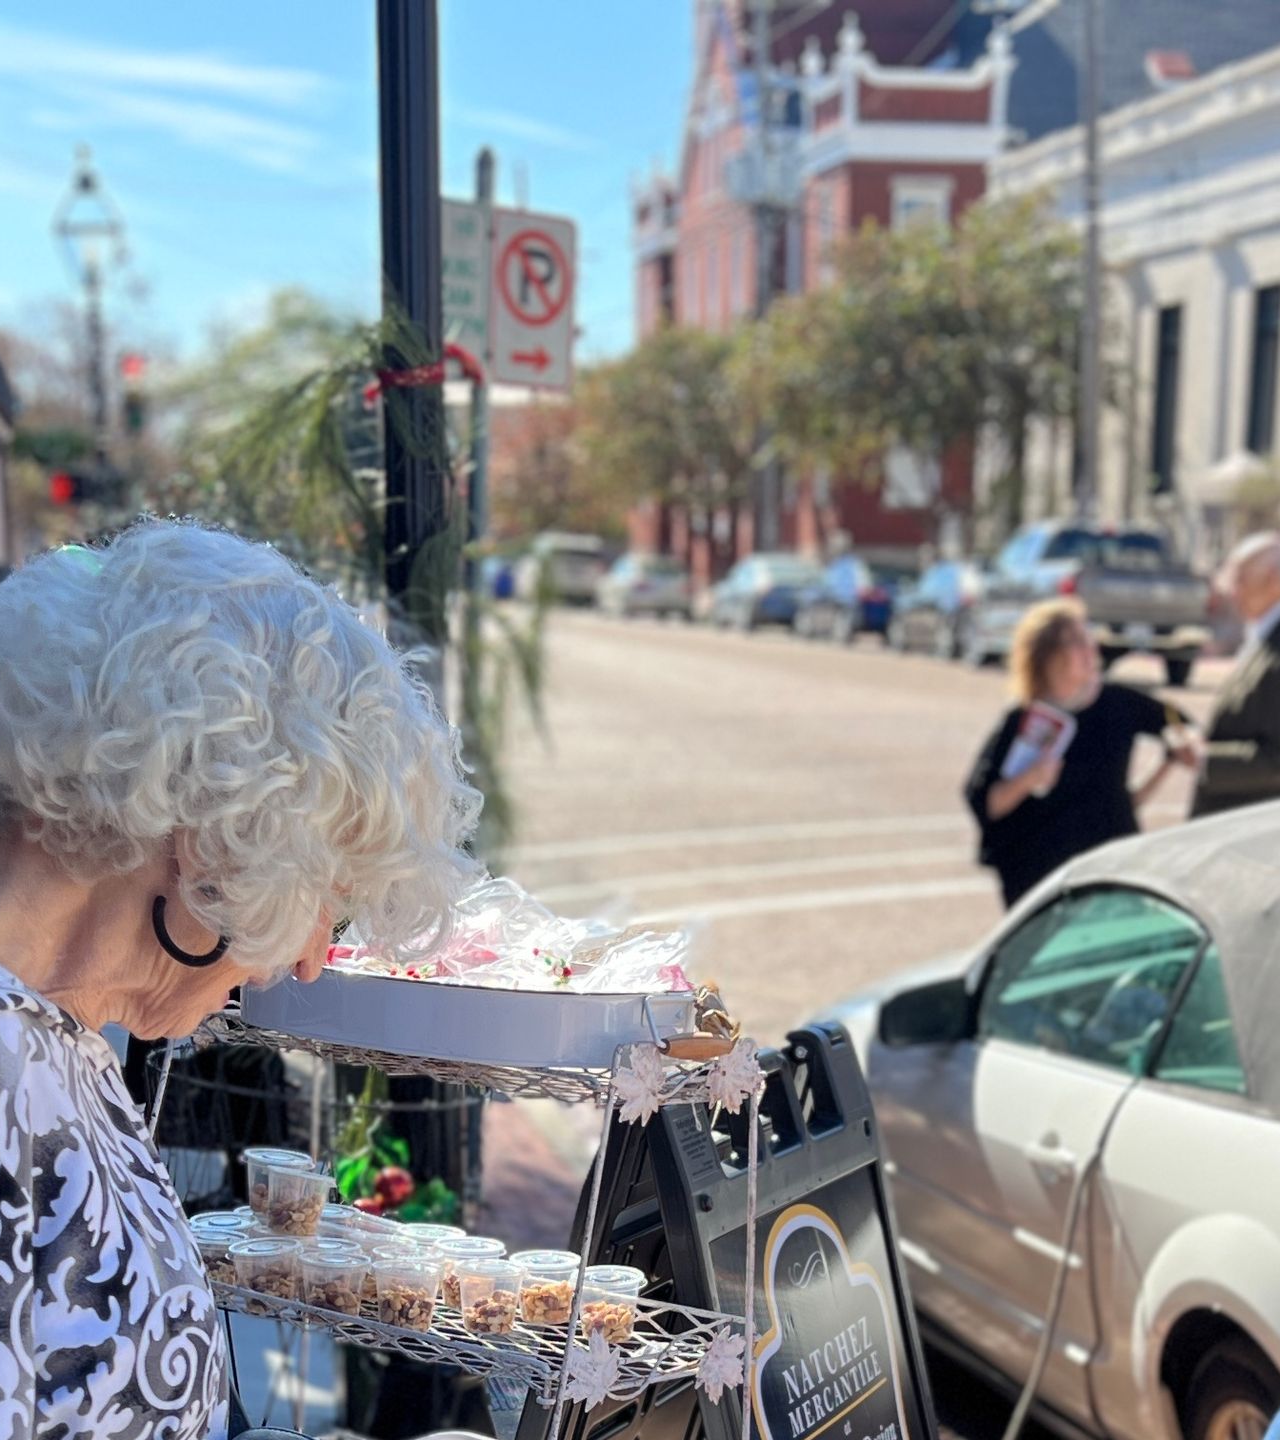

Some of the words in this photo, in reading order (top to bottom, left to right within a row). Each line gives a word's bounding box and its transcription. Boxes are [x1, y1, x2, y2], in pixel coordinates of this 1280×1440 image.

[781, 1315, 873, 1405] NATCHEZ
[787, 1350, 883, 1439] MERCANTILE
[843, 1419, 852, 1437] at
